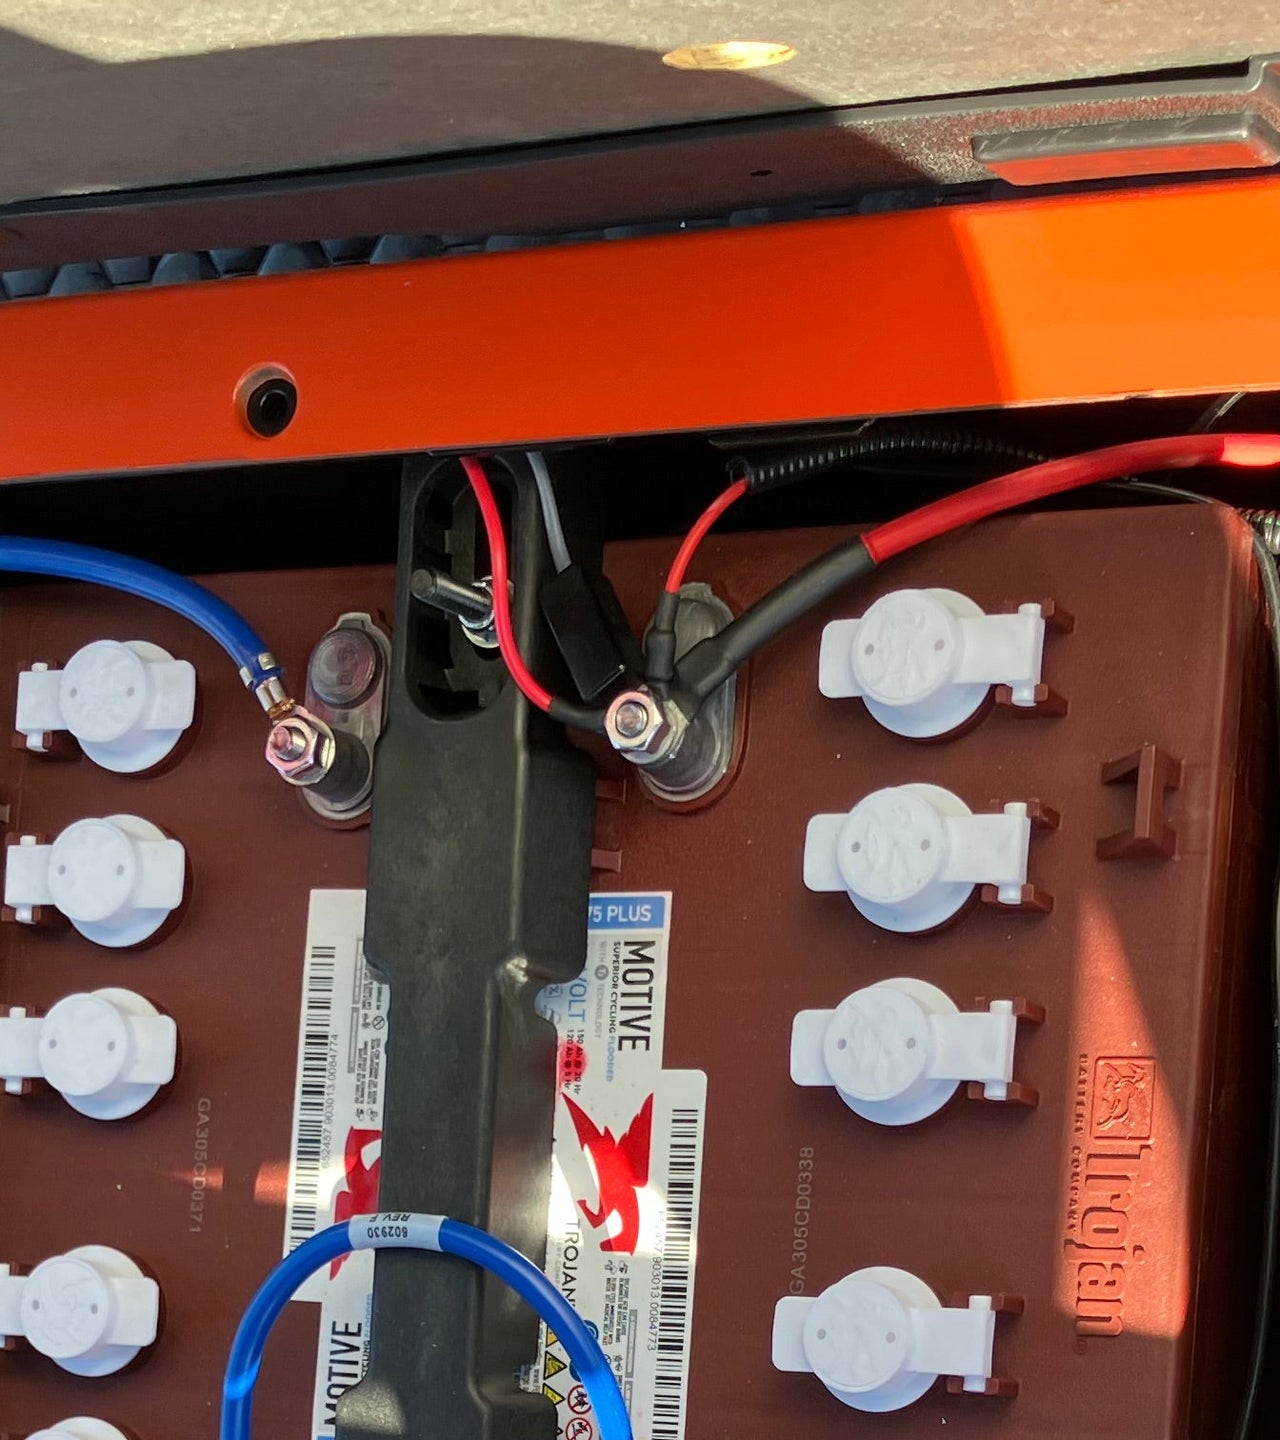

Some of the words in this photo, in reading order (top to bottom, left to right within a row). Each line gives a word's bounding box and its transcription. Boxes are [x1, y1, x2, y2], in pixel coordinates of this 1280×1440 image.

[607, 905, 652, 923] PLUS
[611, 940, 622, 990] SUPERIOR
[608, 991, 619, 1034] CYCLING
[617, 940, 657, 1052] MOTIVE
[605, 1036, 617, 1083] FLOODED
[1063, 1144, 1154, 1338] Trojan
